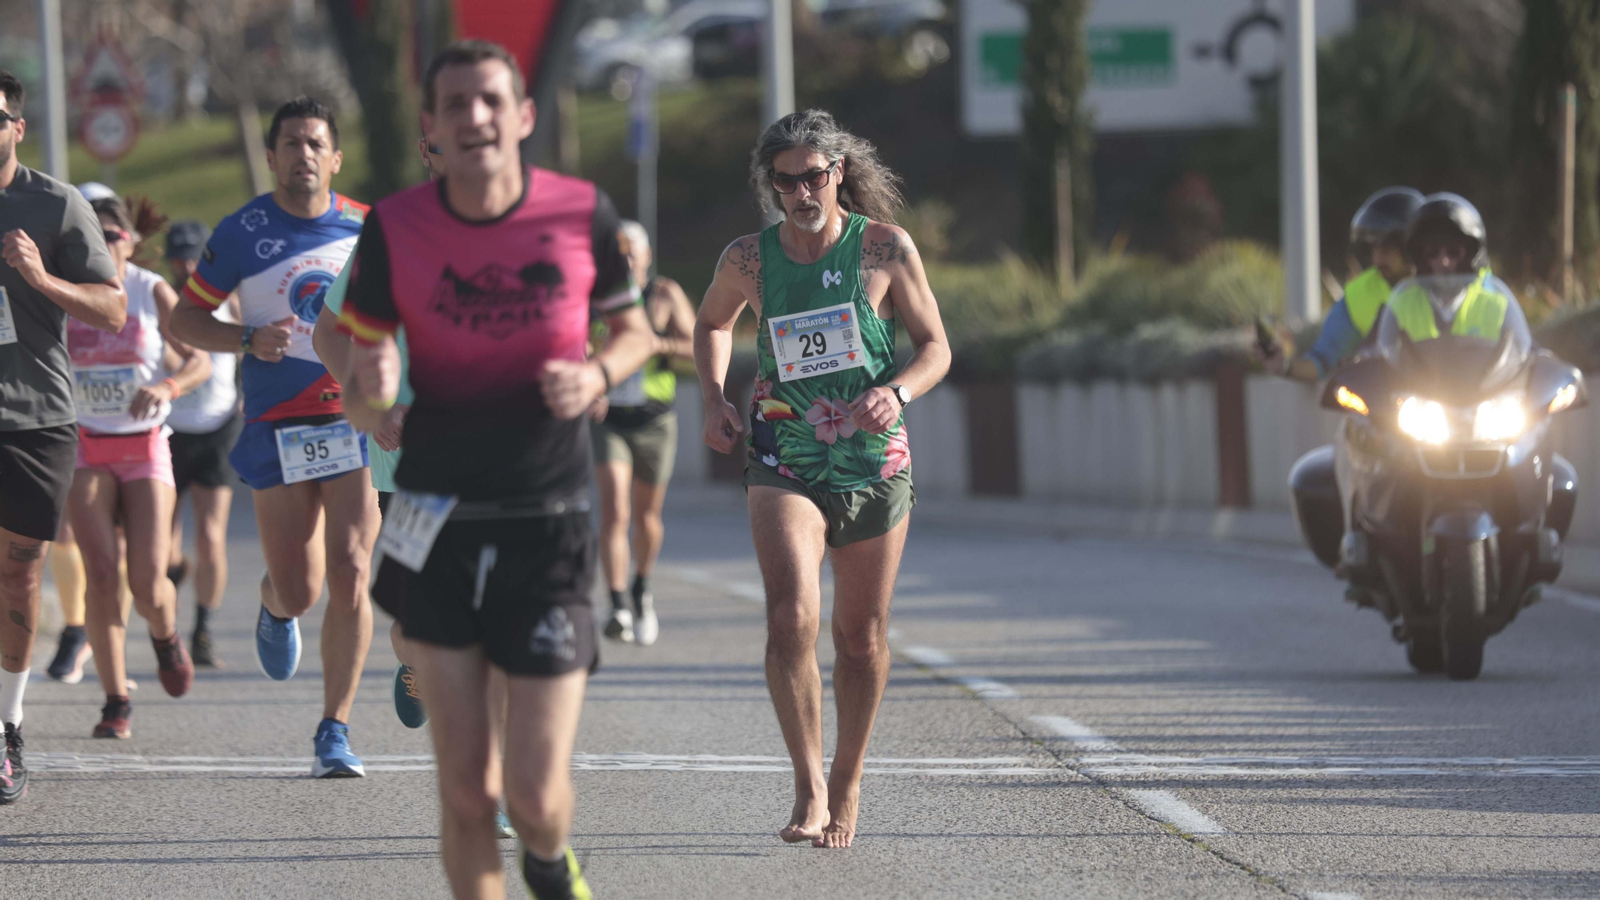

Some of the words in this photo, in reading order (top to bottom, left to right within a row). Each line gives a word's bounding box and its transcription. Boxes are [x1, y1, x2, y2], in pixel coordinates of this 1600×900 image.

[277, 259, 322, 295] RUNNING
[794, 316, 829, 329] MARATÓN
[798, 331, 827, 359] 29
[800, 359, 839, 373] EVOS
[81, 381, 125, 403] 1005
[303, 439, 330, 463] 95
[304, 463, 340, 476] EVOS
